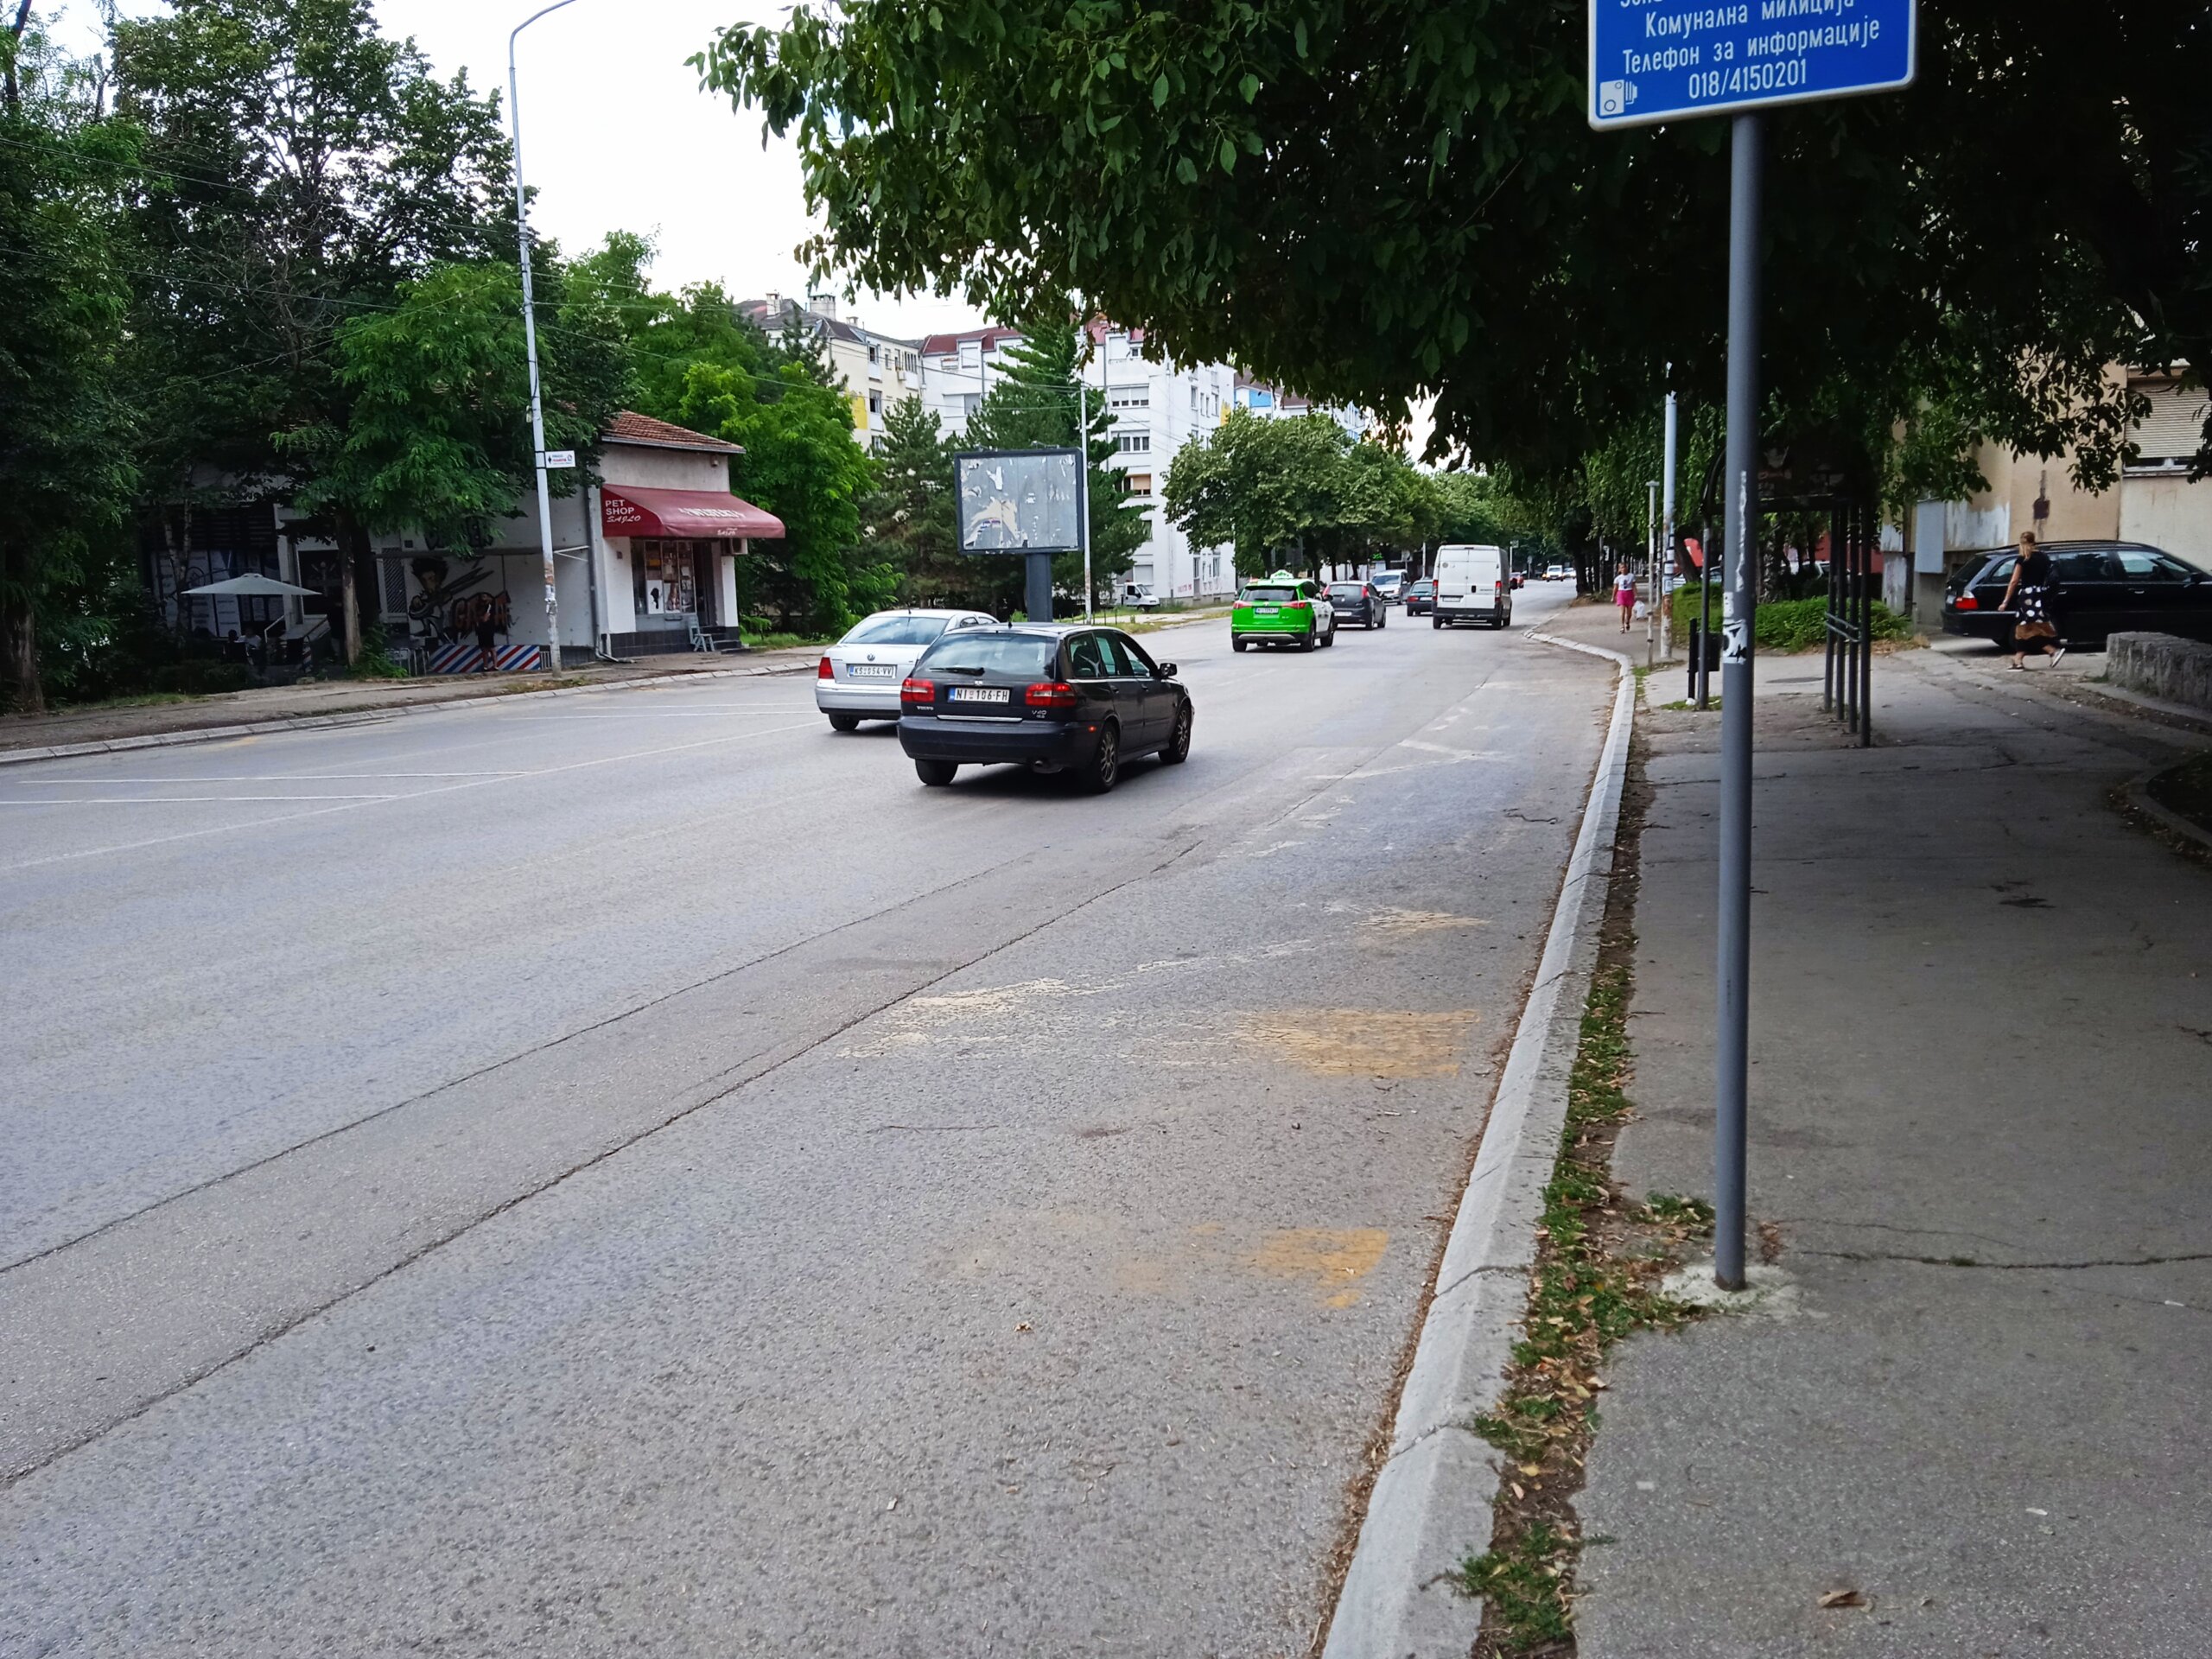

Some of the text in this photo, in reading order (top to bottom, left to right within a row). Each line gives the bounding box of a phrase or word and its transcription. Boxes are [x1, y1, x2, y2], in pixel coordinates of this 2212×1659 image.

[1645, 3, 1748, 40] Комунална
[1622, 15, 1880, 75] Телефон за информације
[1688, 58, 1807, 99] 018/4150201
[956, 690, 967, 700] NI
